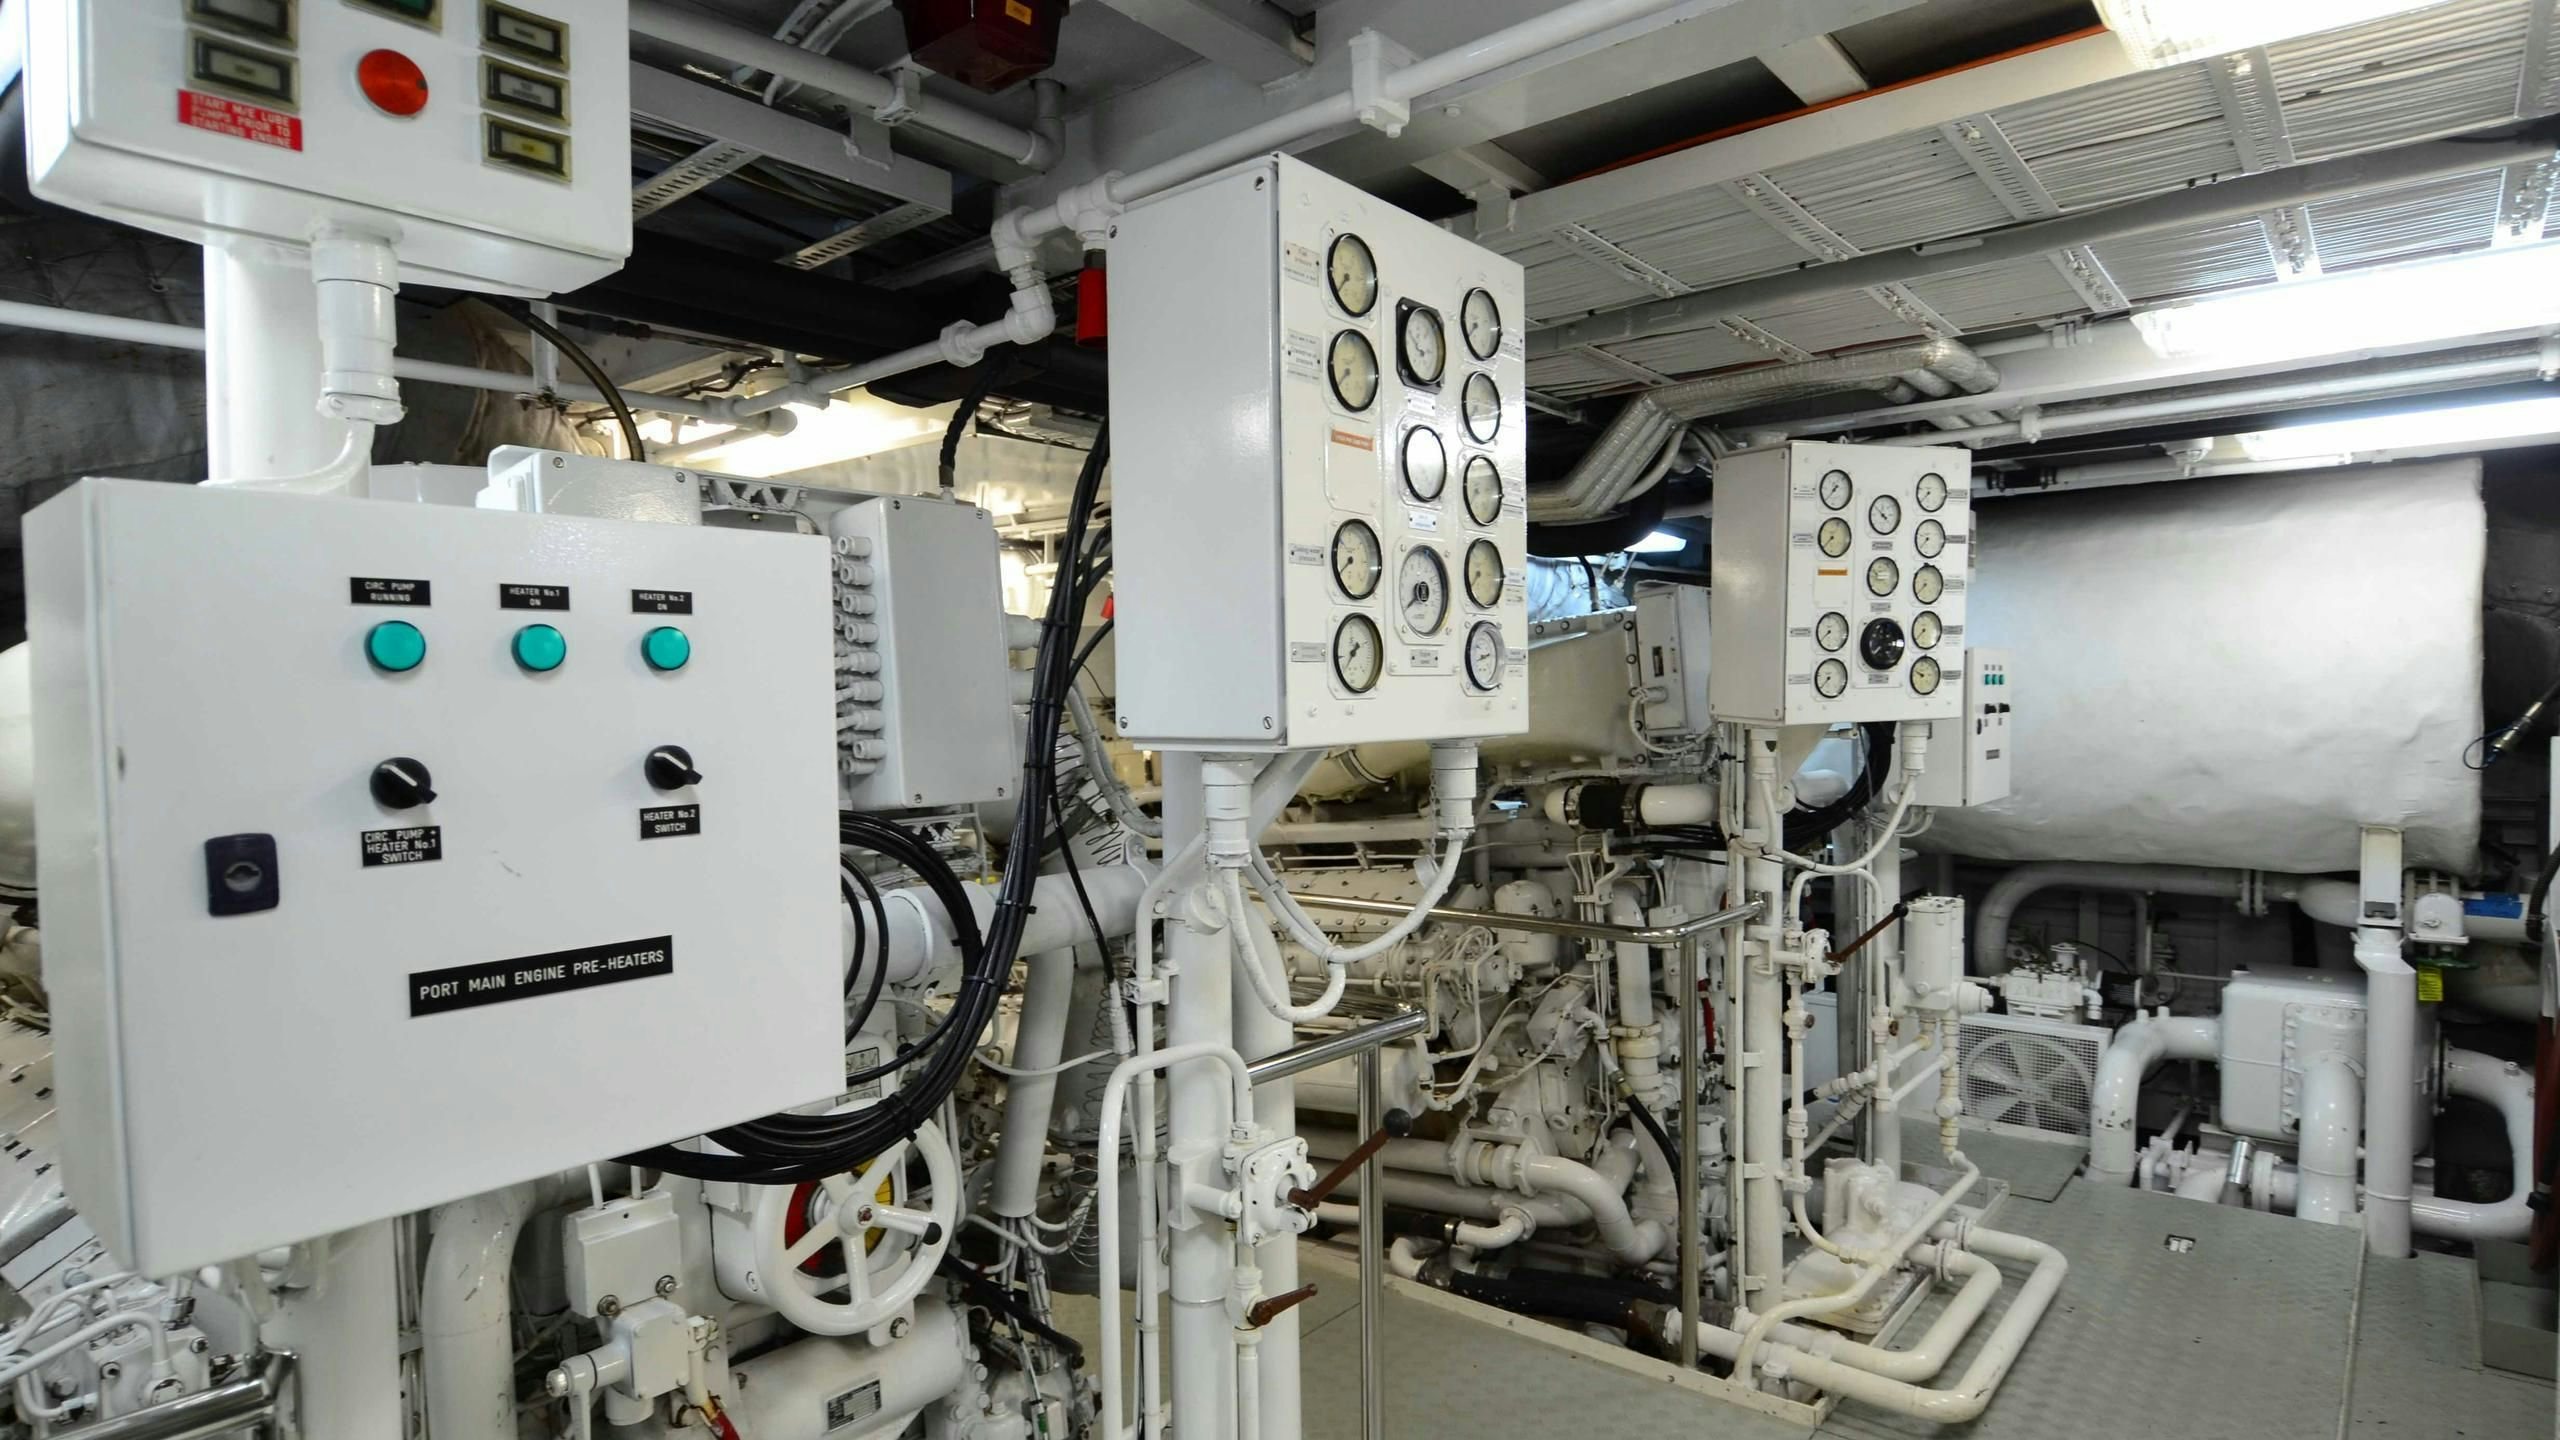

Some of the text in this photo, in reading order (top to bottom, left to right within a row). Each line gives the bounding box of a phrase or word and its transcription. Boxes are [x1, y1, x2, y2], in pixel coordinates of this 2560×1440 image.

[192, 94, 226, 108] START
[237, 115, 271, 131] PRIOR
[277, 124, 291, 137] TO
[252, 129, 290, 147] ENGINE
[391, 582, 416, 591] PUMP
[509, 587, 540, 596] HEATER
[370, 592, 411, 602] RUNNING
[529, 598, 542, 606] ON
[639, 592, 666, 601] HEATER
[657, 603, 668, 611] ON
[643, 808, 696, 822] HEATER No.2
[396, 828, 425, 841] PUMP
[654, 822, 687, 834] SWITCH
[367, 838, 437, 854] HEATER No.1
[382, 850, 423, 864] SWITCH
[420, 950, 665, 1000] PORT MAIN ENGINE PRE-HEATERS
